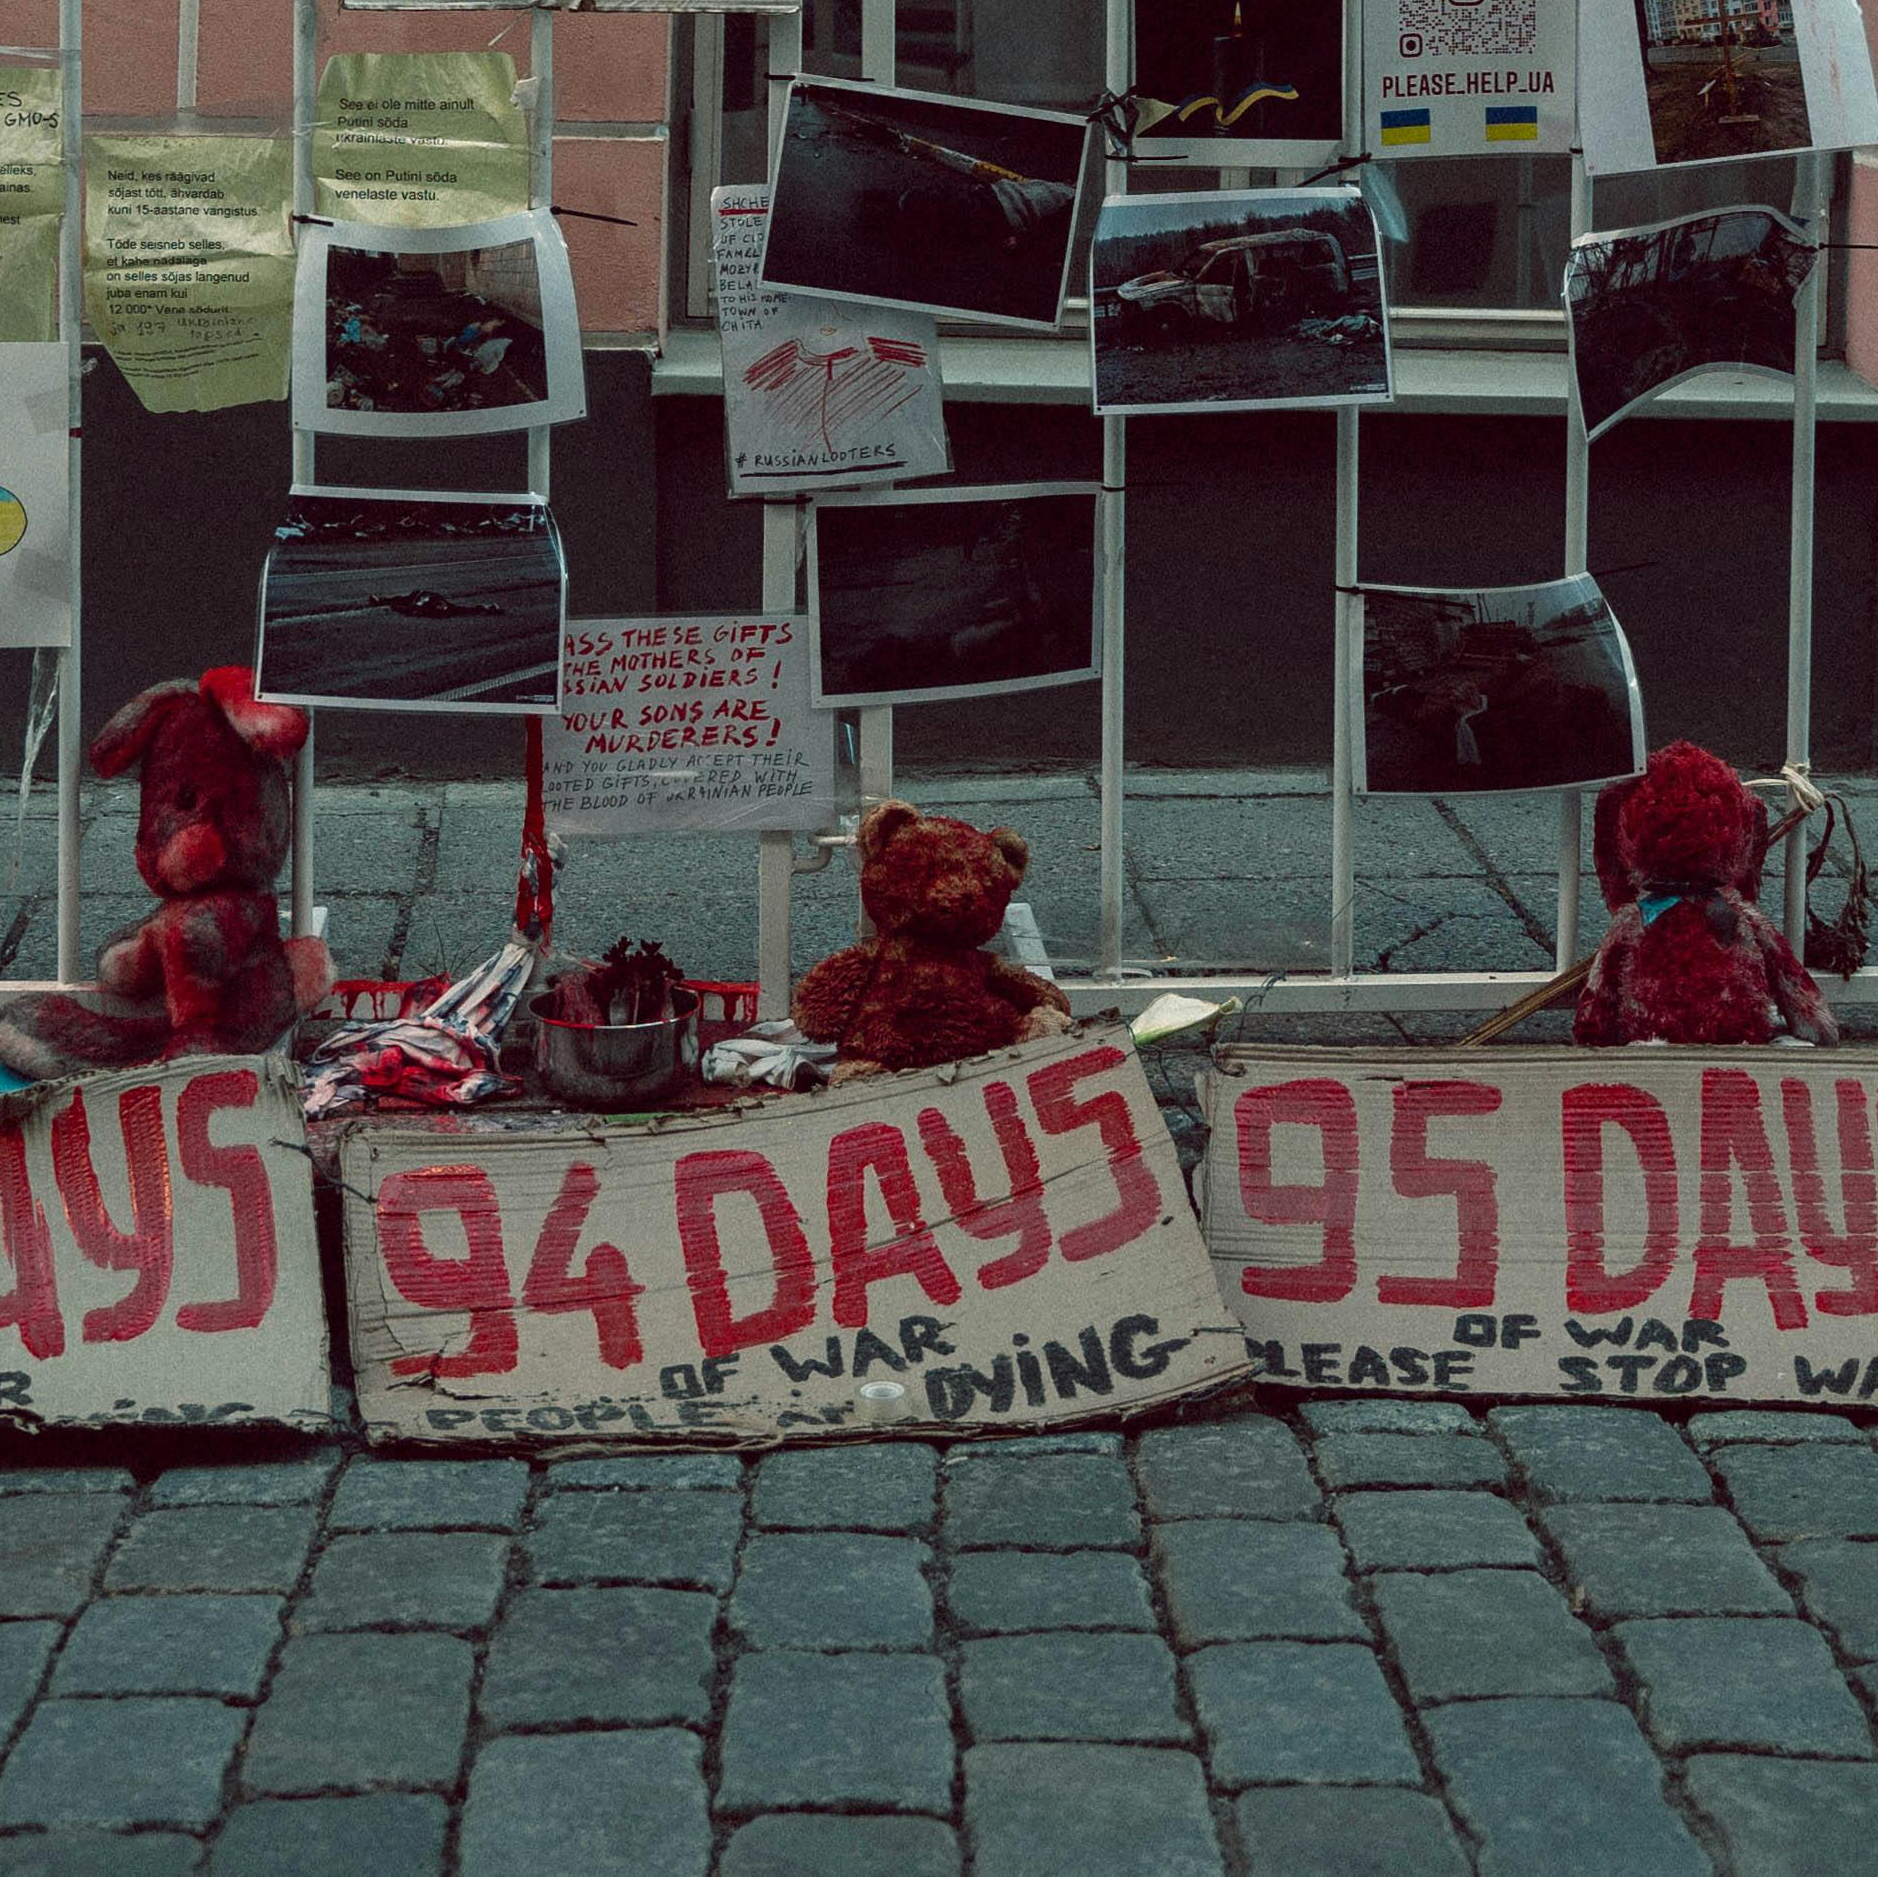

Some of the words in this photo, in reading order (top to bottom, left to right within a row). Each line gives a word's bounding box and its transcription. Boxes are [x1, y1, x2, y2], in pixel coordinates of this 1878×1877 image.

[1383, 71, 1555, 98] PLEASE_HELP_UA
[339, 98, 362, 110] See
[367, 99, 378, 110] ei
[381, 99, 401, 110] ole
[405, 100, 436, 110] mitte
[439, 99, 475, 110] ainult
[338, 117, 373, 128] Putini
[377, 117, 408, 128] sõda
[141, 172, 162, 182] kes
[165, 172, 215, 184] räägivad
[335, 170, 362, 182] See
[365, 172, 381, 182] on
[386, 170, 421, 182] Putini
[426, 172, 457, 183] sõda
[108, 188, 142, 200] sõjast
[170, 189, 225, 200] ähvardab
[335, 190, 398, 200] venelaste
[402, 190, 439, 201] vastu.
[108, 204, 132, 215] kuni
[136, 205, 199, 216] 15-aastane
[107, 238, 137, 250] Tõde
[140, 239, 185, 250] seisneb
[107, 257, 119, 266] et
[121, 257, 149, 266] kahe
[107, 273, 121, 281] on
[125, 271, 158, 282] selles
[162, 272, 191, 285] sõjas
[195, 272, 250, 285] langenud
[107, 288, 131, 300] juba
[135, 290, 166, 299] enam
[171, 288, 187, 298] kui
[109, 304, 123, 314] 12
[156, 305, 186, 315] Vene
[723, 306, 756, 317] TOWN
[621, 625, 702, 649] THESE
[610, 648, 716, 674] MOTHERS
[730, 647, 766, 664] OF
[562, 708, 628, 731] YOUR
[639, 700, 704, 726] SONS
[585, 719, 781, 754] MURDERERS!
[582, 760, 608, 772] YOU
[617, 755, 677, 772] GLADLY
[579, 796, 628, 810] BLOOD
[637, 793, 658, 806] OF
[757, 781, 813, 797] PEOPLE
[1233, 1074, 1503, 1308] 95
[376, 1161, 648, 1380] 94
[673, 1045, 1162, 1359] DAYS
[1452, 1314, 1543, 1352] OF
[1562, 1316, 1731, 1353] WAR
[659, 1352, 741, 1401] OF
[768, 1315, 958, 1383] WAR
[1558, 1352, 1748, 1395] STOP
[426, 1401, 722, 1431] PEOPLE
